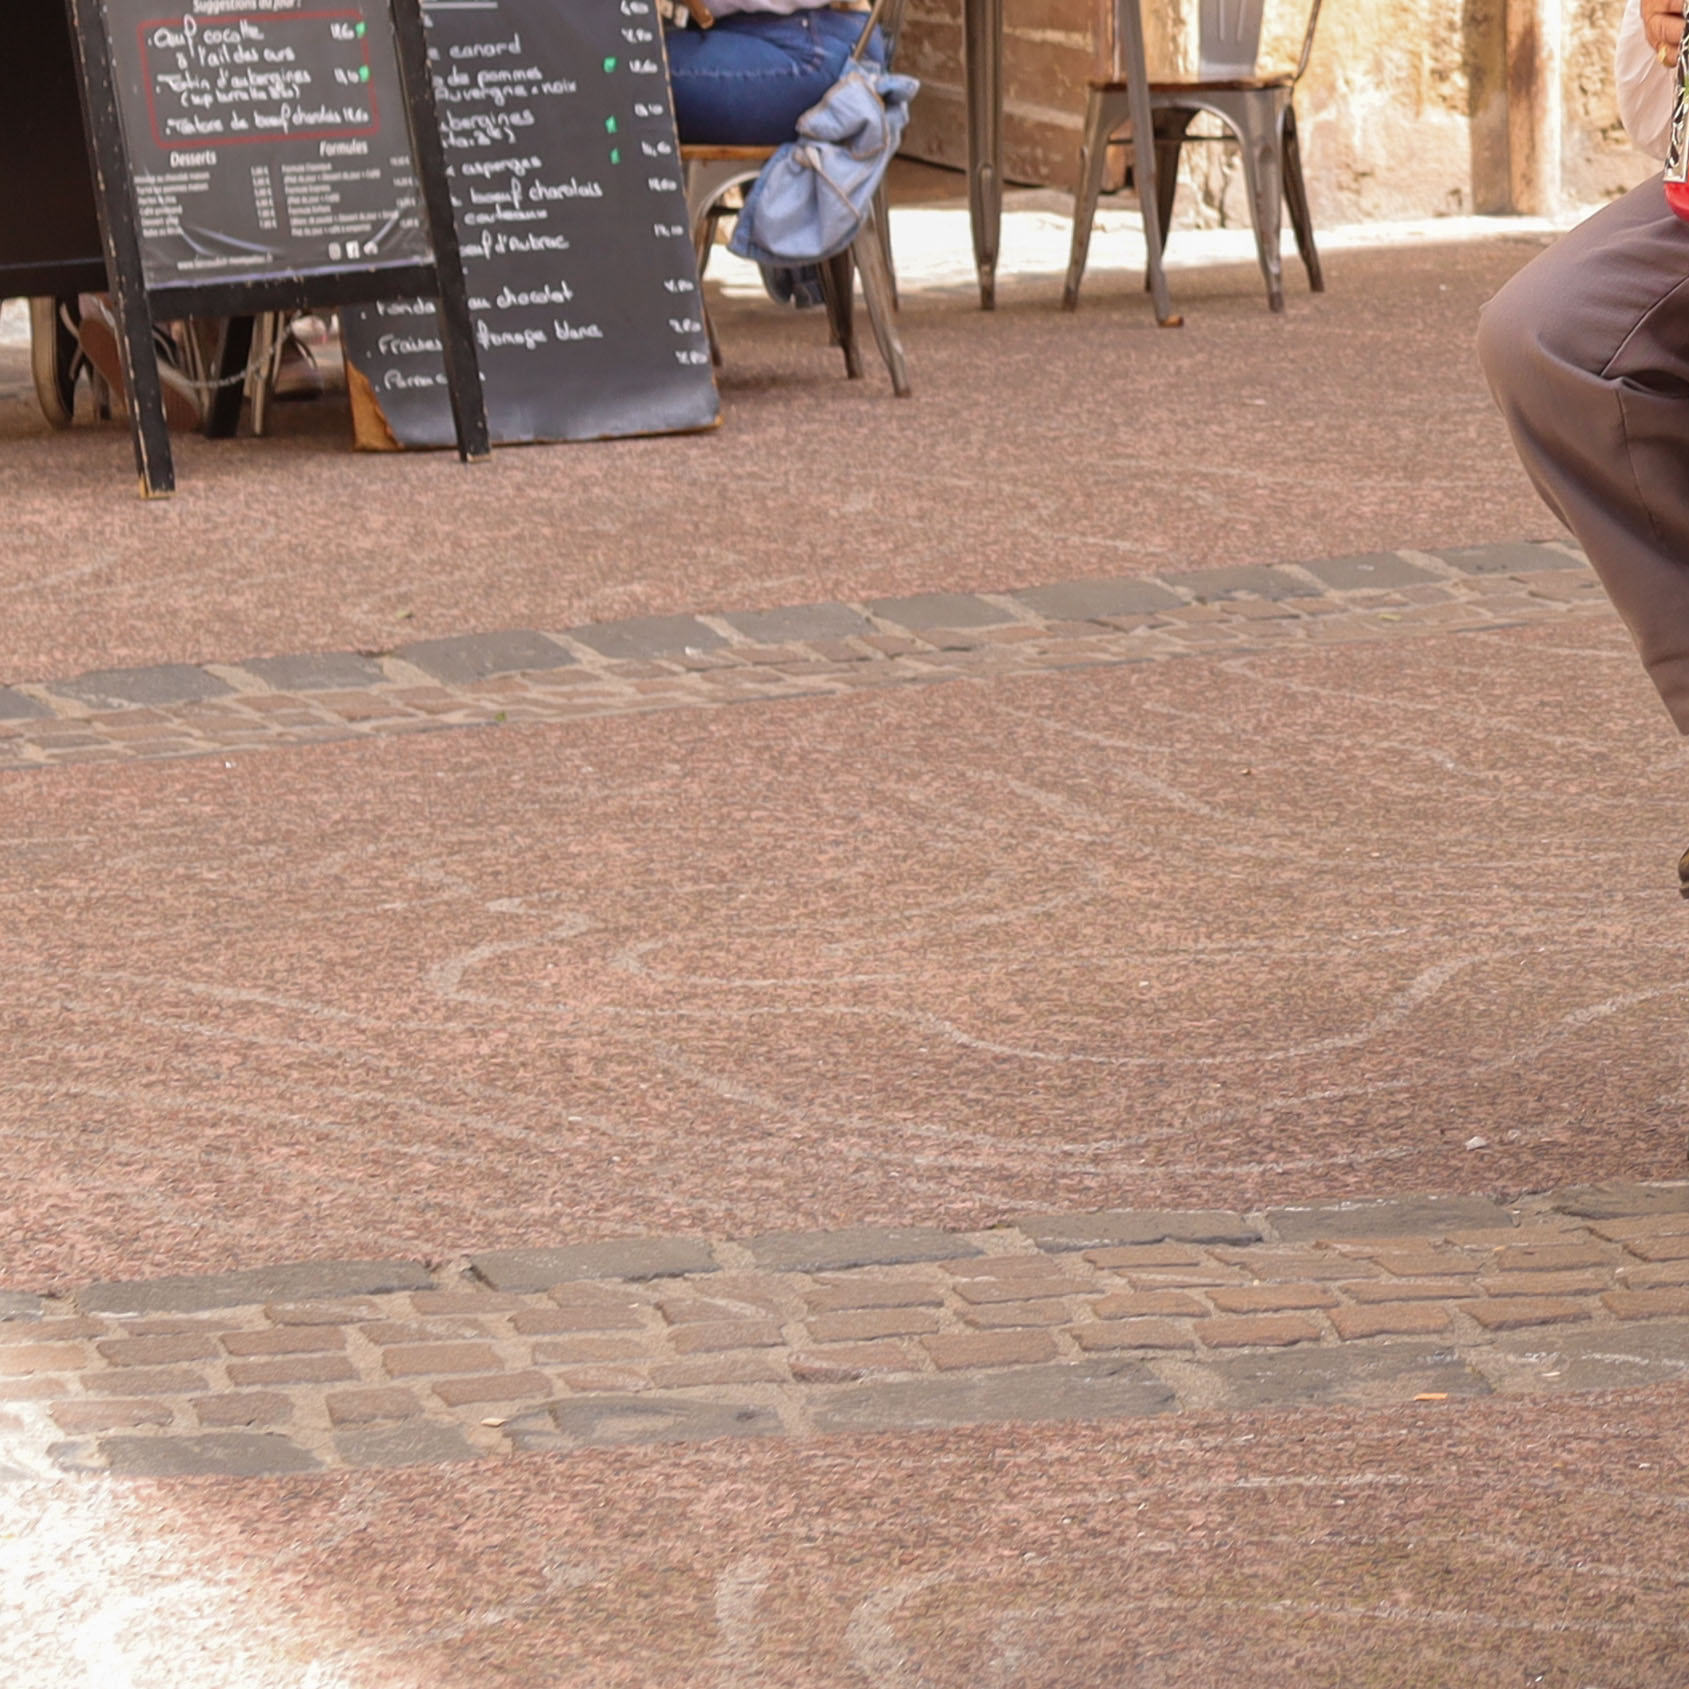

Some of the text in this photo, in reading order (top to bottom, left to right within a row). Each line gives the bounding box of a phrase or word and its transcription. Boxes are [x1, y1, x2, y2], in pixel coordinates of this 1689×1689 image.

[449, 32, 522, 61] canard
[477, 66, 544, 90] pommes
[170, 150, 217, 168] Desserts
[319, 139, 368, 157] Formules
[461, 155, 543, 179] asperges
[528, 176, 604, 202] charolais
[498, 280, 574, 310] chocolat
